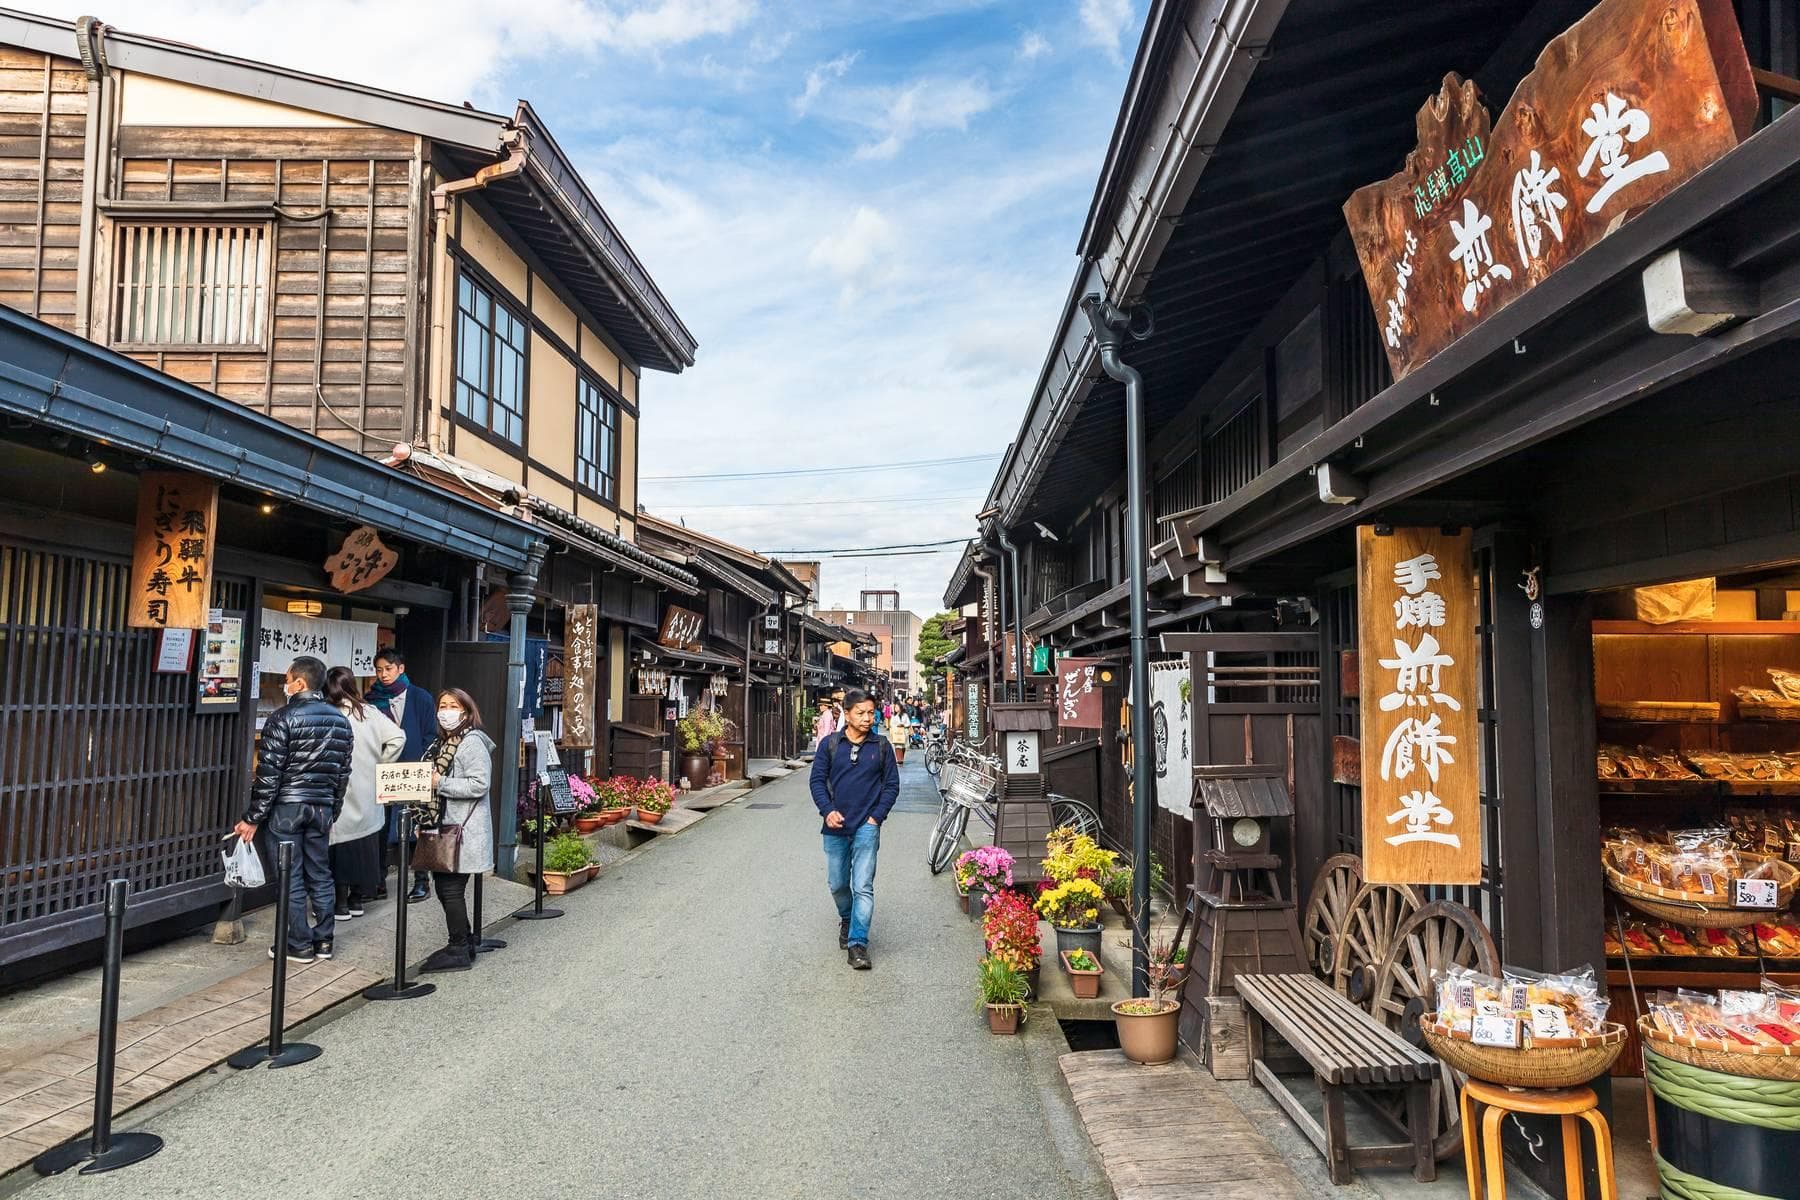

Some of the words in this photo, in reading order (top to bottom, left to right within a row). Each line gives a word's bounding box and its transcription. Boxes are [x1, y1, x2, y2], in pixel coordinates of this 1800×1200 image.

[1449, 92, 1670, 312] 煎餅堂
[147, 485, 180, 625] にぎり寿司
[1063, 668, 1081, 720] ぜんざい
